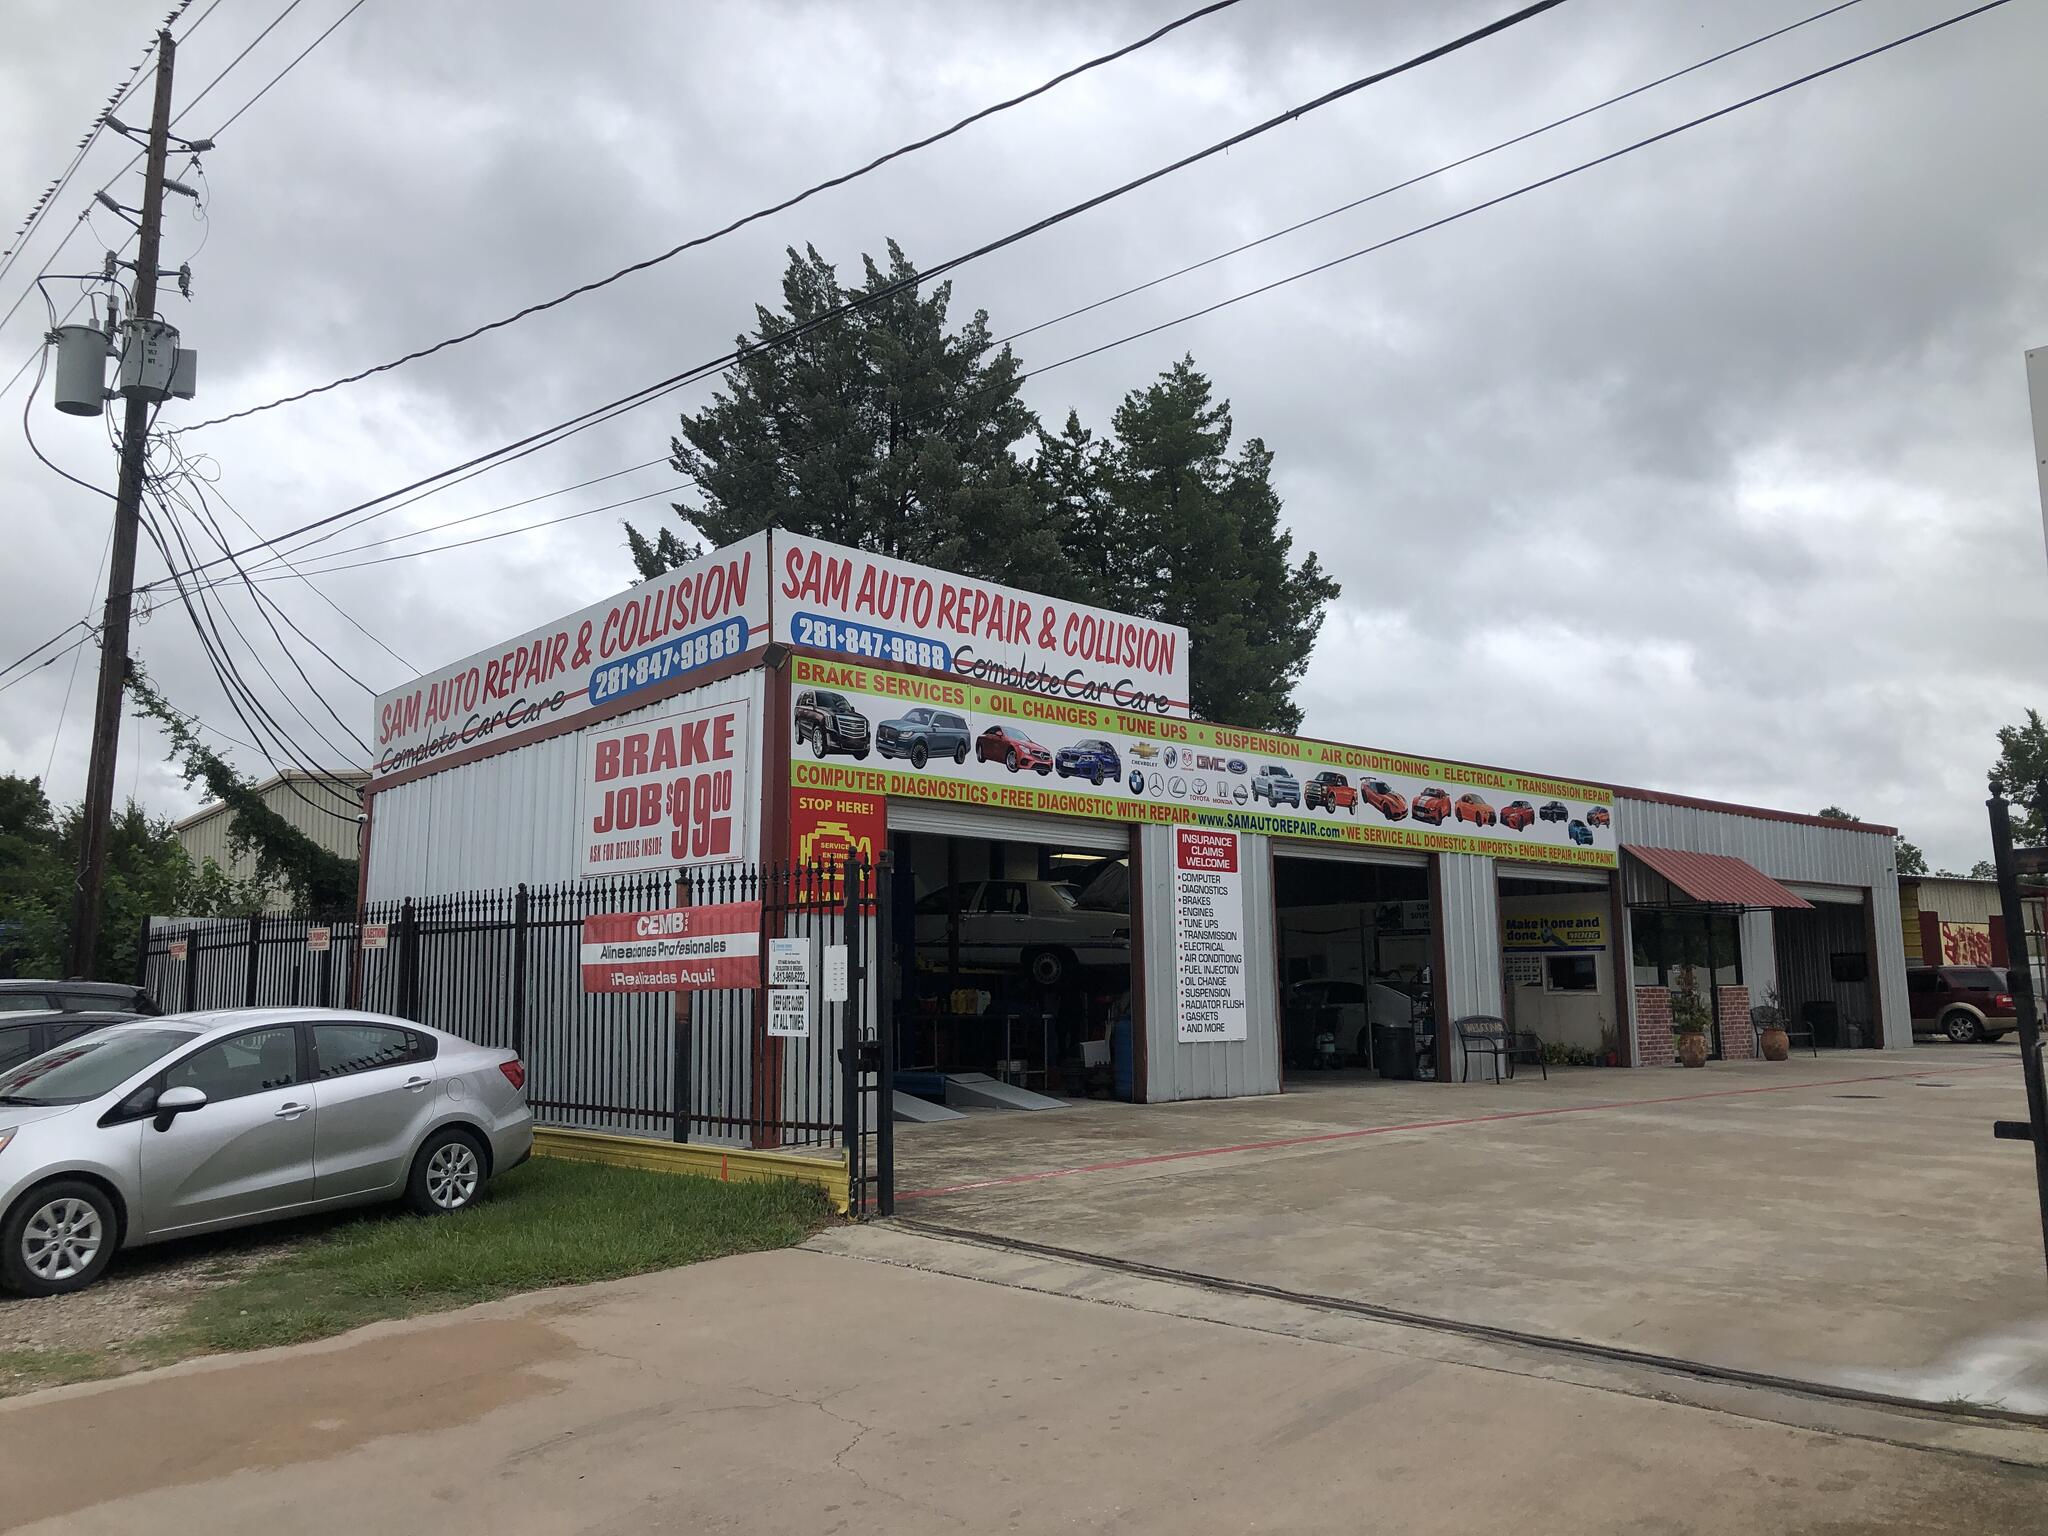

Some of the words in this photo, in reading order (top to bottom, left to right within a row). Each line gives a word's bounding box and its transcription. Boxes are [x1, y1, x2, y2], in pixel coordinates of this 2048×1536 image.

[782, 547, 852, 613] SAM
[855, 564, 933, 628] AUTO
[938, 585, 1031, 645] REPAIR
[1038, 606, 1057, 651] &
[1064, 612, 1176, 675] COLLISION
[380, 691, 422, 744] SAM
[424, 665, 479, 728] AUTO
[483, 632, 569, 706] REPAIR
[571, 620, 593, 671] &
[600, 551, 751, 659] COLLISION
[797, 661, 867, 689] BRAKE
[873, 671, 964, 705] SERVICES
[953, 645, 1061, 695] Complete
[1063, 670, 1111, 702] Car
[1113, 679, 1170, 713] Care
[990, 695, 1017, 714] OIL
[1023, 700, 1097, 727] CHANGES
[380, 723, 457, 775] Complete
[461, 710, 504, 744] Car
[505, 691, 565, 729] Care
[1117, 715, 1156, 736] TUNE
[1160, 724, 1188, 740] UPS
[595, 713, 735, 783] BRAKE
[1215, 731, 1300, 758] SUSPENSION
[1197, 755, 1226, 772] GMC
[1321, 748, 1342, 763] AIR
[1346, 751, 1430, 777] CONDITIONING
[796, 764, 886, 792] COMPUTER
[891, 776, 988, 803] DIAGNOSTICS
[1444, 767, 1506, 788] ELECTRICAL
[1190, 794, 1210, 803] TOYOTA
[1516, 778, 1581, 800] TRANSMISSION
[1583, 788, 1611, 803] REPAIR
[593, 783, 662, 833] JOB
[800, 797, 833, 811] STOP
[836, 801, 874, 815] HERE!
[1001, 789, 1033, 809] FREE
[1038, 794, 1113, 817] DIAGNOSTIC
[1117, 802, 1146, 819] WITH
[1150, 806, 1190, 824] REPAIR
[1198, 813, 1340, 838] www.SAMAUTOREPAIR.com
[821, 842, 850, 850] SERVICE
[1182, 833, 1232, 847] INSURANCE
[1346, 826, 1361, 840] WE
[1364, 828, 1403, 845] SERVICE
[1406, 832, 1422, 847] ALL
[1424, 836, 1468, 851] DOMESTIC
[1469, 840, 1476, 852] &
[1478, 840, 1513, 855] IMPORTS
[590, 846, 601, 863] ASK
[602, 843, 614, 861] FOR
[616, 839, 640, 860] DETAILS
[642, 837, 663, 857] INSIDE
[1191, 846, 1224, 857] CLAIMS
[1519, 844, 1548, 859] ENGINE
[1550, 847, 1572, 860] REPAIR
[1577, 850, 1595, 862] AUTO
[1596, 852, 1614, 865] PAINT
[1186, 856, 1230, 869] WELCOME
[1181, 873, 1221, 883] COMPUTER
[1182, 884, 1228, 895] DIAGNOSTICS
[1182, 896, 1211, 905] BRAKES
[1182, 907, 1214, 917] ENGINES
[637, 912, 684, 936] CEMB
[1183, 918, 1203, 928] TUNE
[1204, 919, 1219, 928] UPS
[1506, 919, 1538, 930] Make
[1540, 918, 1549, 929] it
[1551, 920, 1574, 929] one
[1575, 917, 1600, 928] and
[1184, 930, 1237, 940] TRANSMISSION
[1507, 930, 1540, 940] done.
[658, 938, 726, 956] Profesionales
[1184, 942, 1225, 951] ELECTRICAL
[1185, 954, 1197, 963] AIR
[1185, 965, 1203, 974] FUEL
[1204, 965, 1239, 974] INJECTION
[1185, 976, 1196, 985] OIL
[1198, 976, 1227, 985] CHANGE
[1185, 988, 1231, 997] SUSPENSION
[1185, 1000, 1221, 1009] RADIATOR
[1222, 1000, 1244, 1008] FLUSH
[772, 1013, 780, 1030] AT
[780, 1013, 789, 1030] ALL
[789, 1013, 805, 1030] TIMES
[1186, 1012, 1219, 1021] GASKETS
[1186, 1023, 1203, 1033] AND
[1204, 1023, 1225, 1032] MORE
